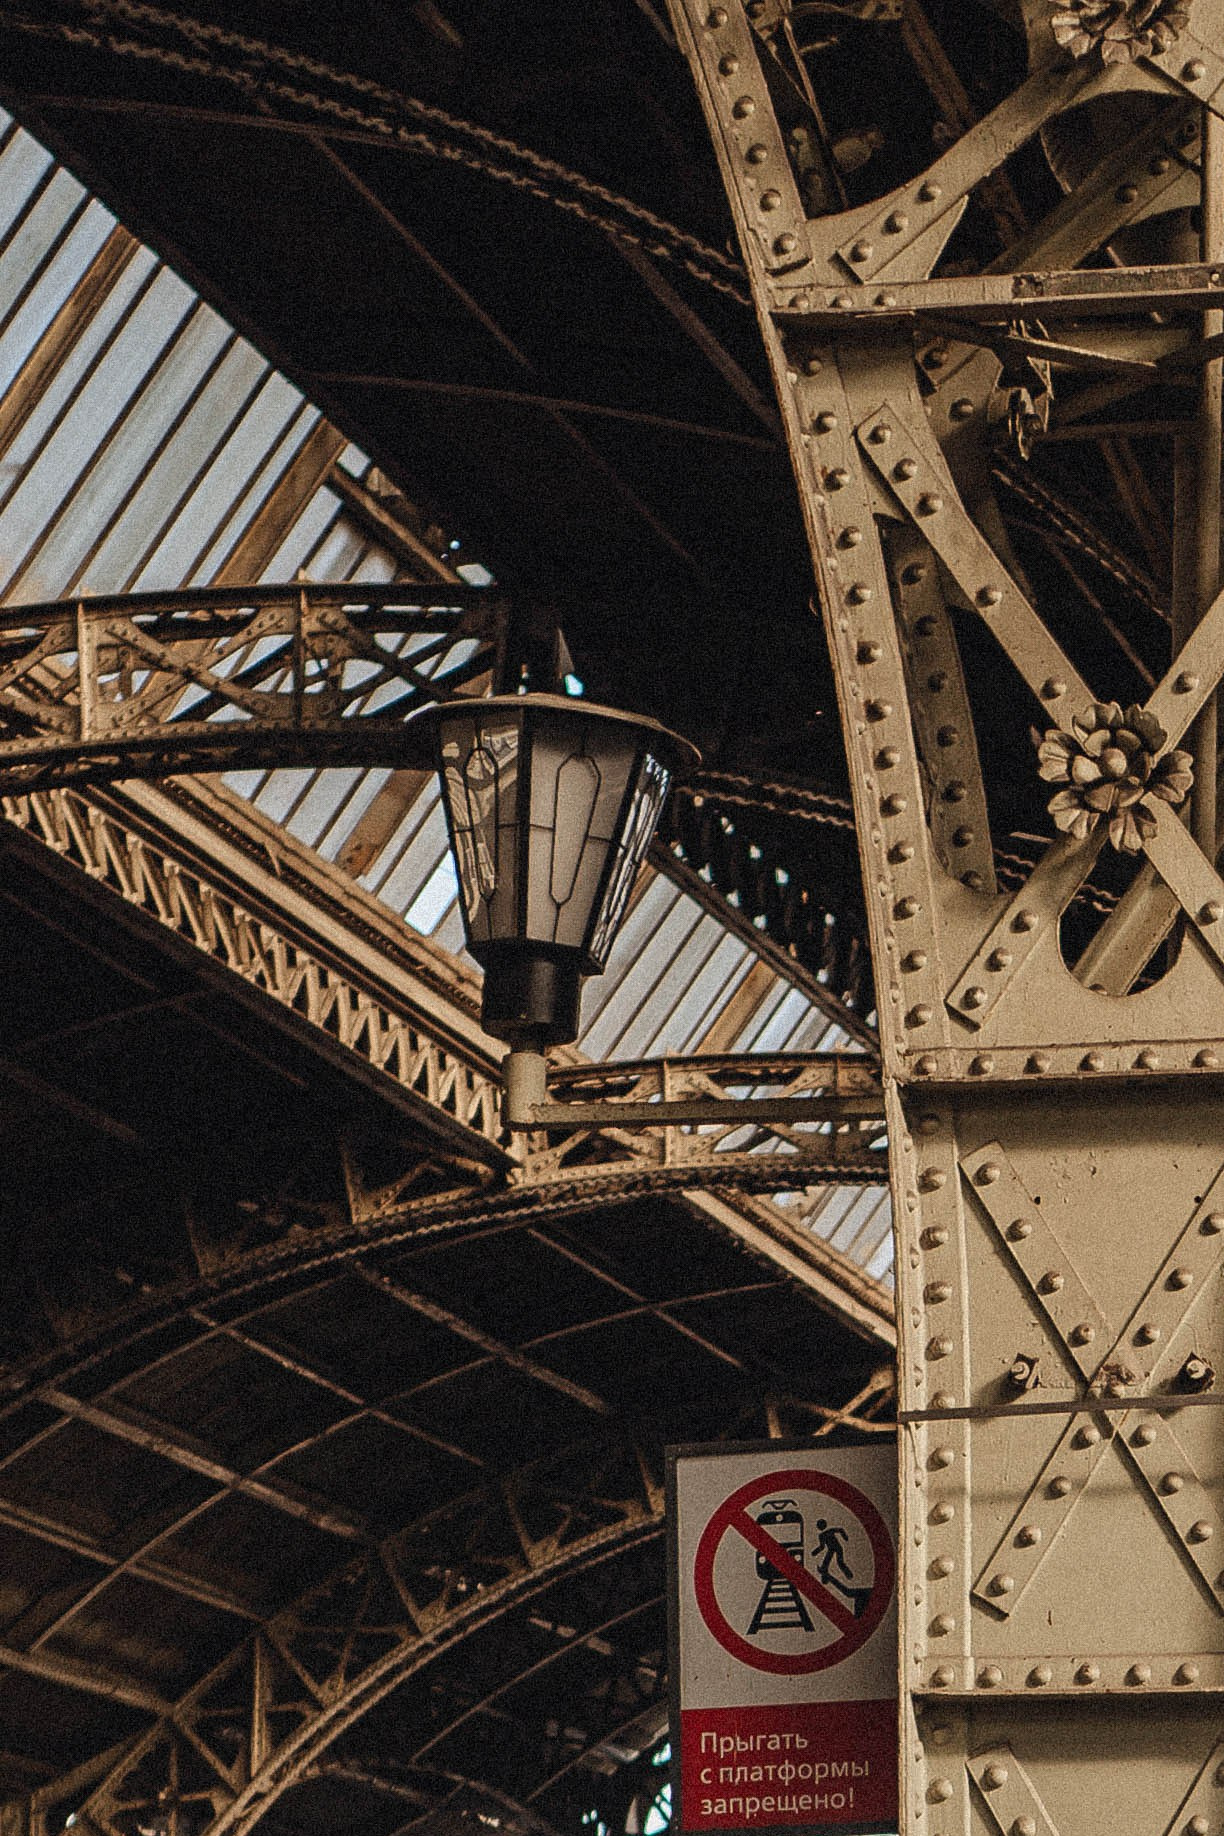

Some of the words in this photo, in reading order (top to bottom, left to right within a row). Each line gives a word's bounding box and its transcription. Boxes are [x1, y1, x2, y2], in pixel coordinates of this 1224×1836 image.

[700, 1731, 808, 1759] Прыгать
[700, 1767, 712, 1784] с
[719, 1759, 870, 1786] платформы
[700, 1787, 855, 1819] запрещено!
